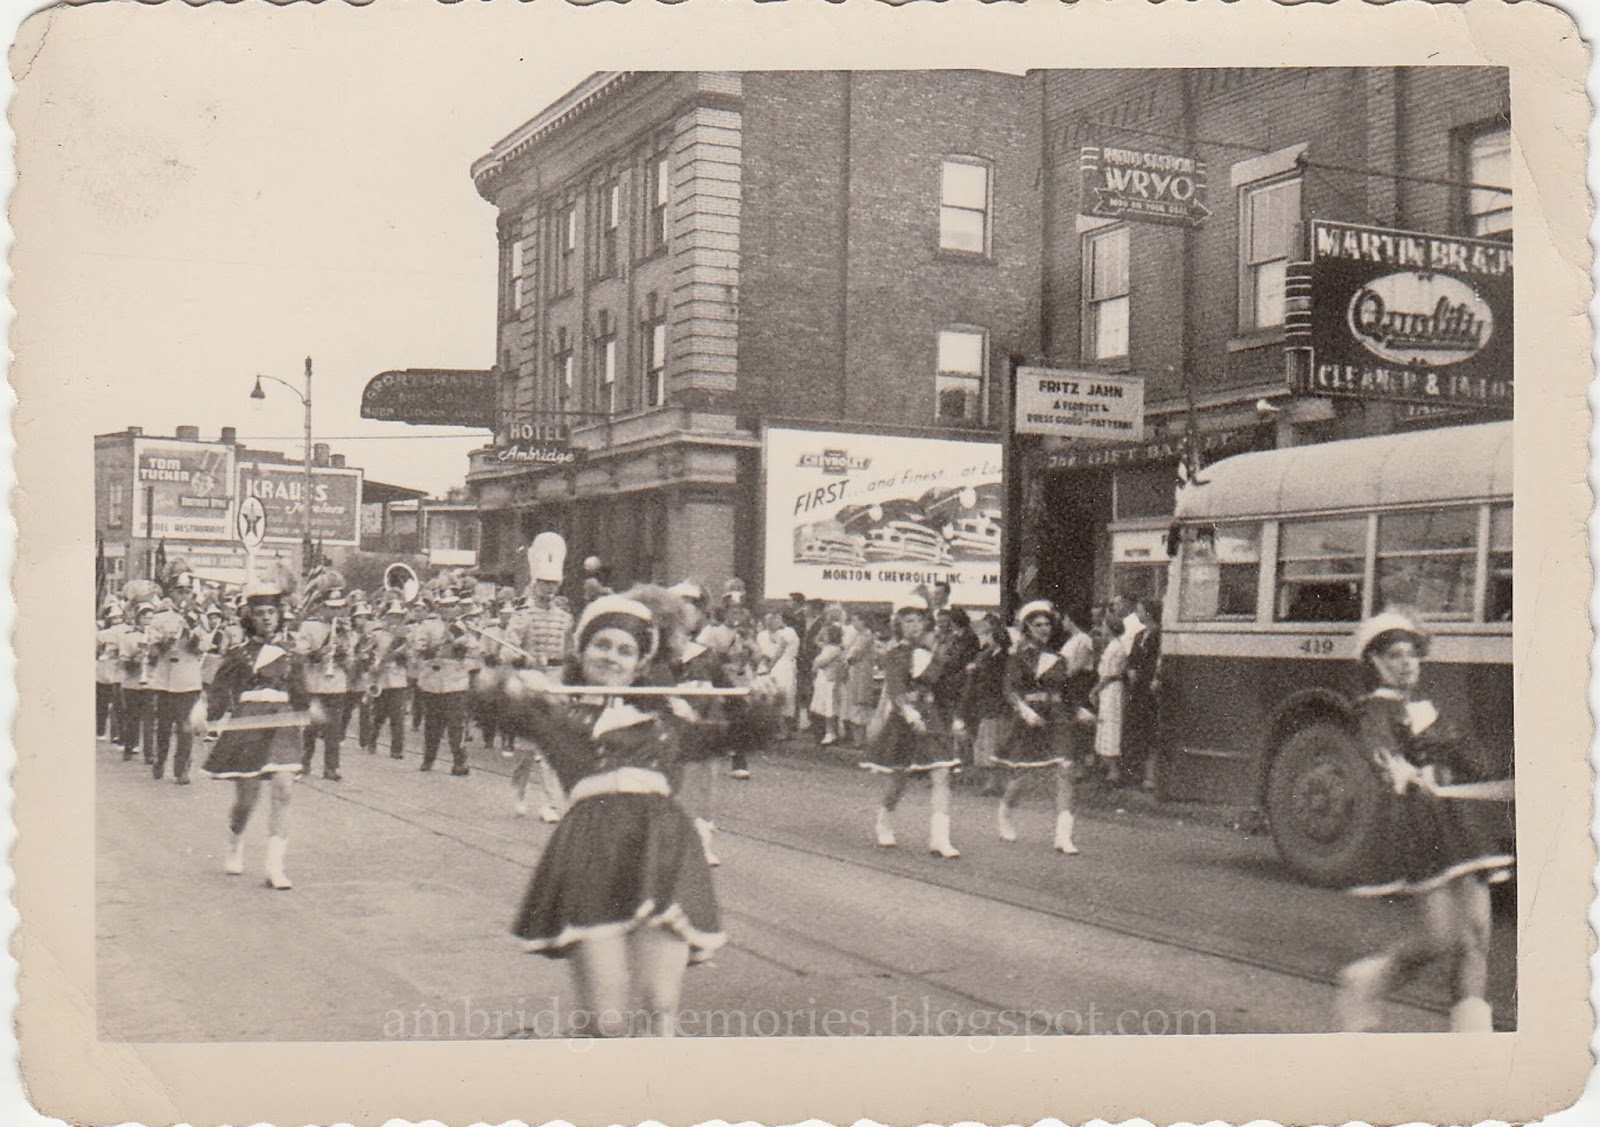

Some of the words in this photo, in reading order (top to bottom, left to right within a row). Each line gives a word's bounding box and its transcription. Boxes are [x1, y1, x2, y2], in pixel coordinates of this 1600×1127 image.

[1104, 166, 1196, 201] WRYO
[1316, 226, 1425, 267] MARTIN
[1352, 287, 1484, 344] Quality
[1038, 380, 1080, 395] FRITZ
[1086, 383, 1123, 398] JAHN
[1424, 373, 1440, 395] &
[510, 423, 565, 441] HOTEL
[498, 445, 575, 463] Ambridge
[148, 458, 181, 470] TOM
[140, 468, 190, 482] TUCKER
[246, 479, 329, 502] KRAUS
[794, 480, 849, 516] FIRST
[868, 476, 895, 491] and
[901, 469, 944, 484] Finest
[961, 466, 976, 477] at
[822, 568, 872, 581] MORTON
[878, 571, 938, 584] CHEVROLET
[982, 574, 1001, 584] AM
[1300, 638, 1334, 654] 419
